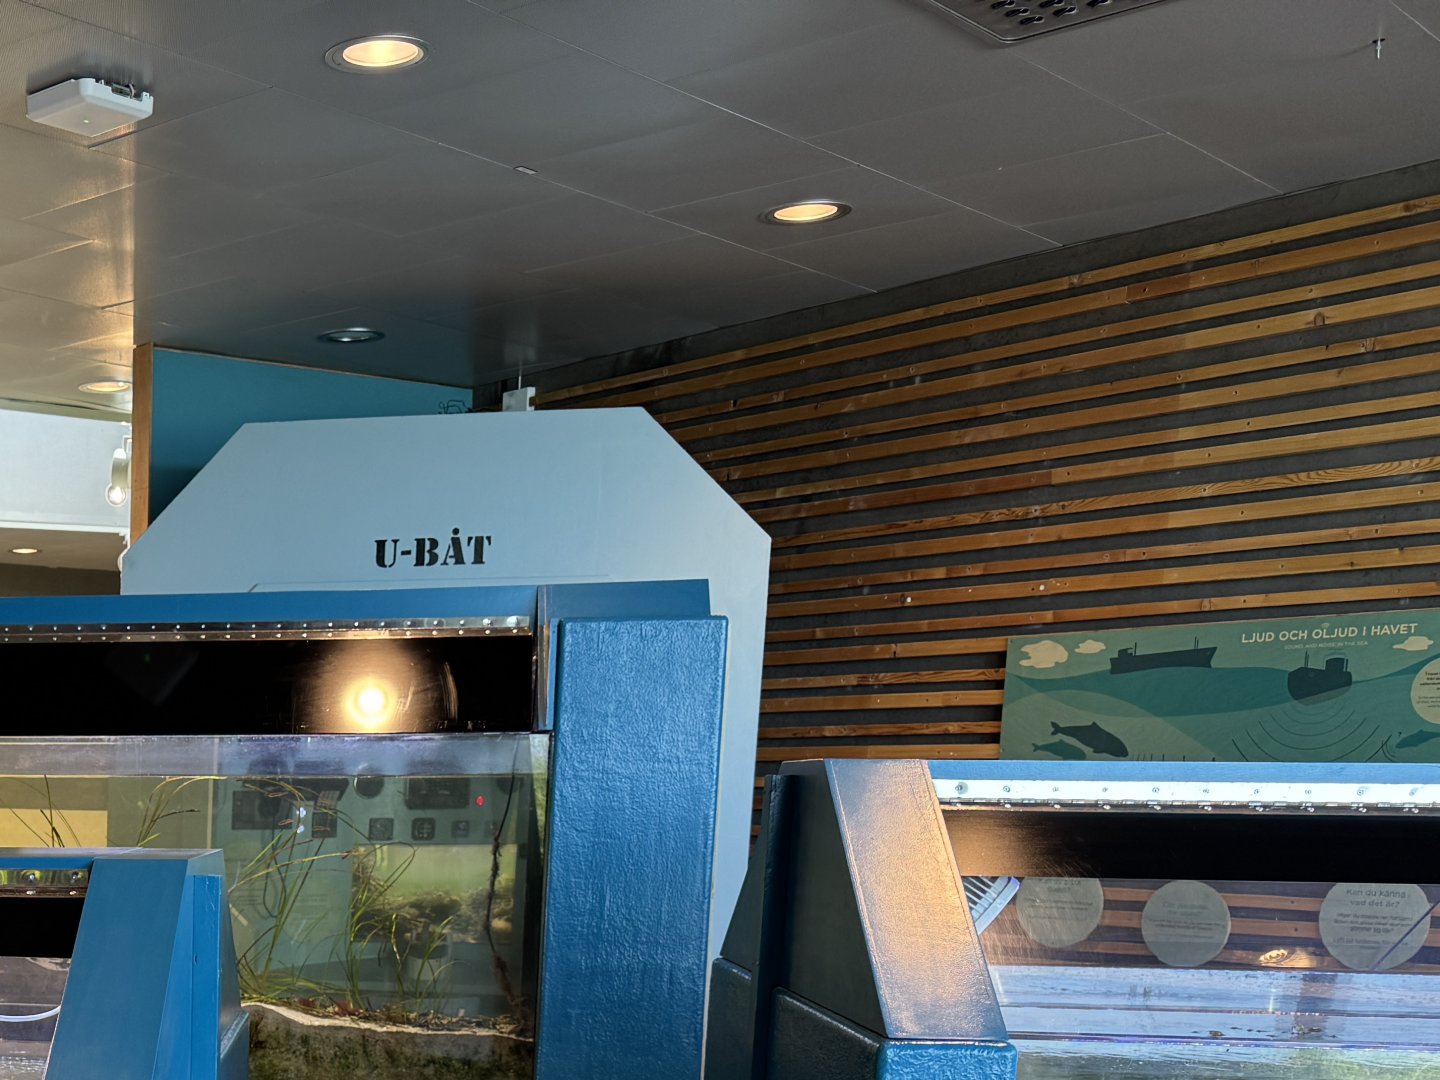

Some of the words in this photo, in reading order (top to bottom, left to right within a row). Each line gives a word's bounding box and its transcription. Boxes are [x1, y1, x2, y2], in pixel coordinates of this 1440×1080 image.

[374, 527, 492, 568] U-BÅT
[1241, 632, 1275, 643] LJUD
[1279, 630, 1308, 641] OCH
[1312, 627, 1358, 639] OLJUD
[1371, 623, 1418, 636] HAVET
